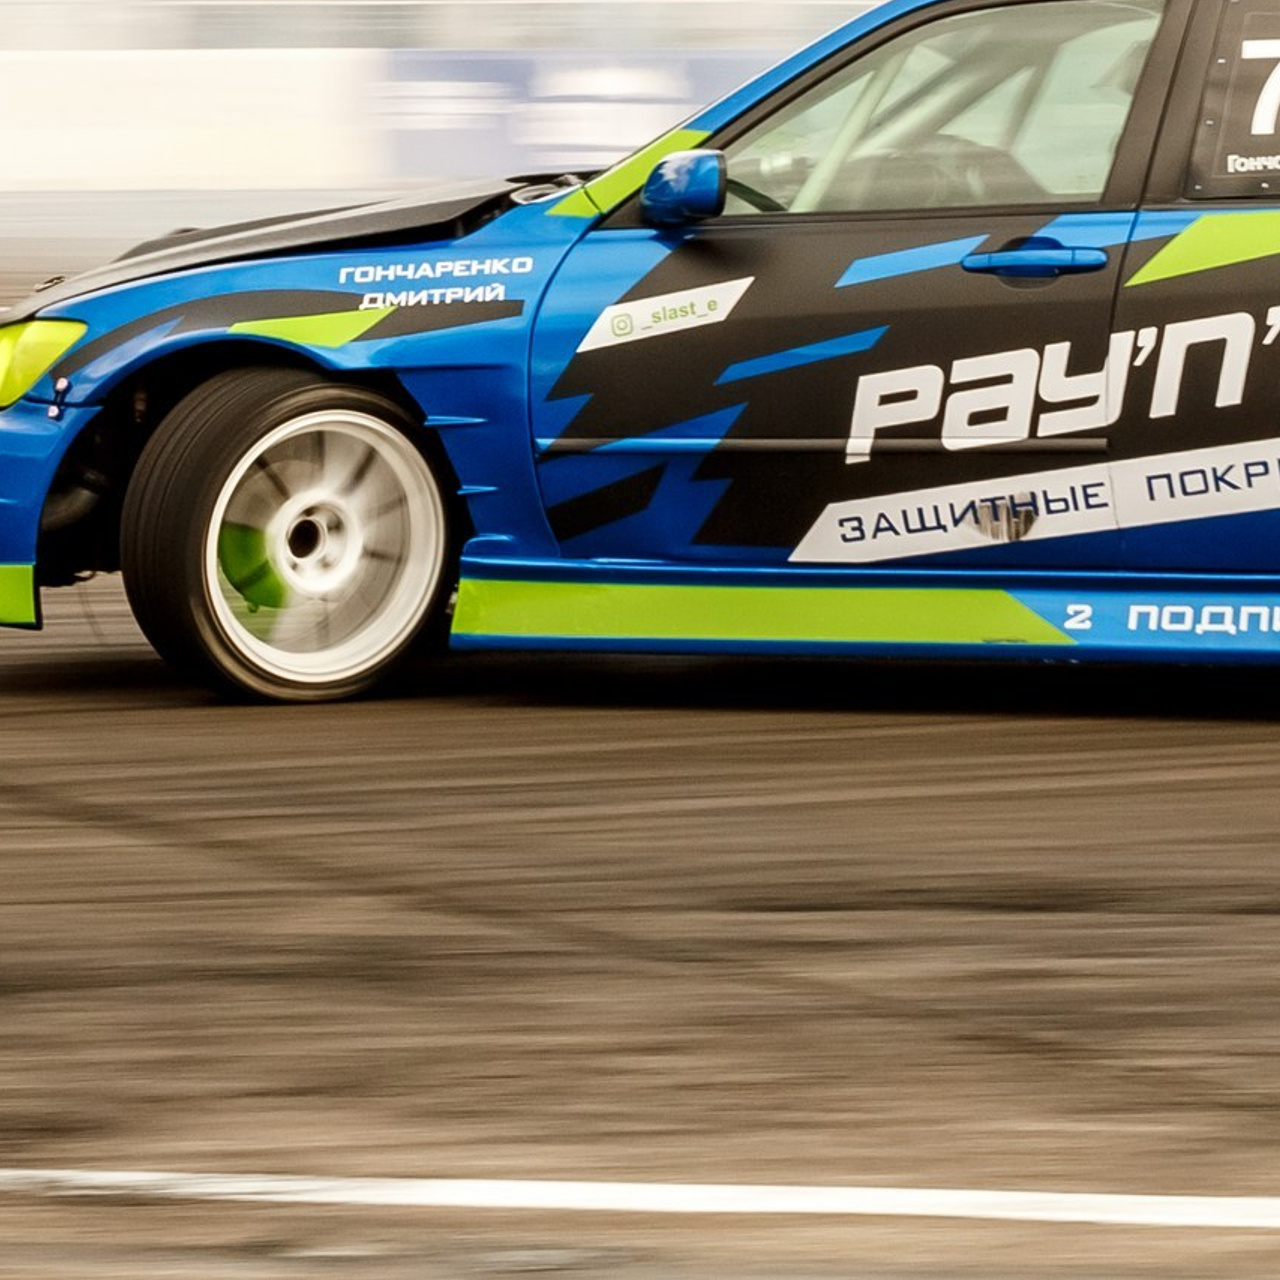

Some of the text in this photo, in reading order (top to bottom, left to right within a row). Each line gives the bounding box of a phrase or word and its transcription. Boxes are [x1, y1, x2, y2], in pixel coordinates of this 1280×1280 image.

[339, 257, 533, 284] ГОНЧАРЕНКО
[359, 283, 505, 311] ДМИТРИЙ
[838, 482, 1110, 544] ЗАЩИТНЫЕ
[1063, 604, 1093, 630] 2
